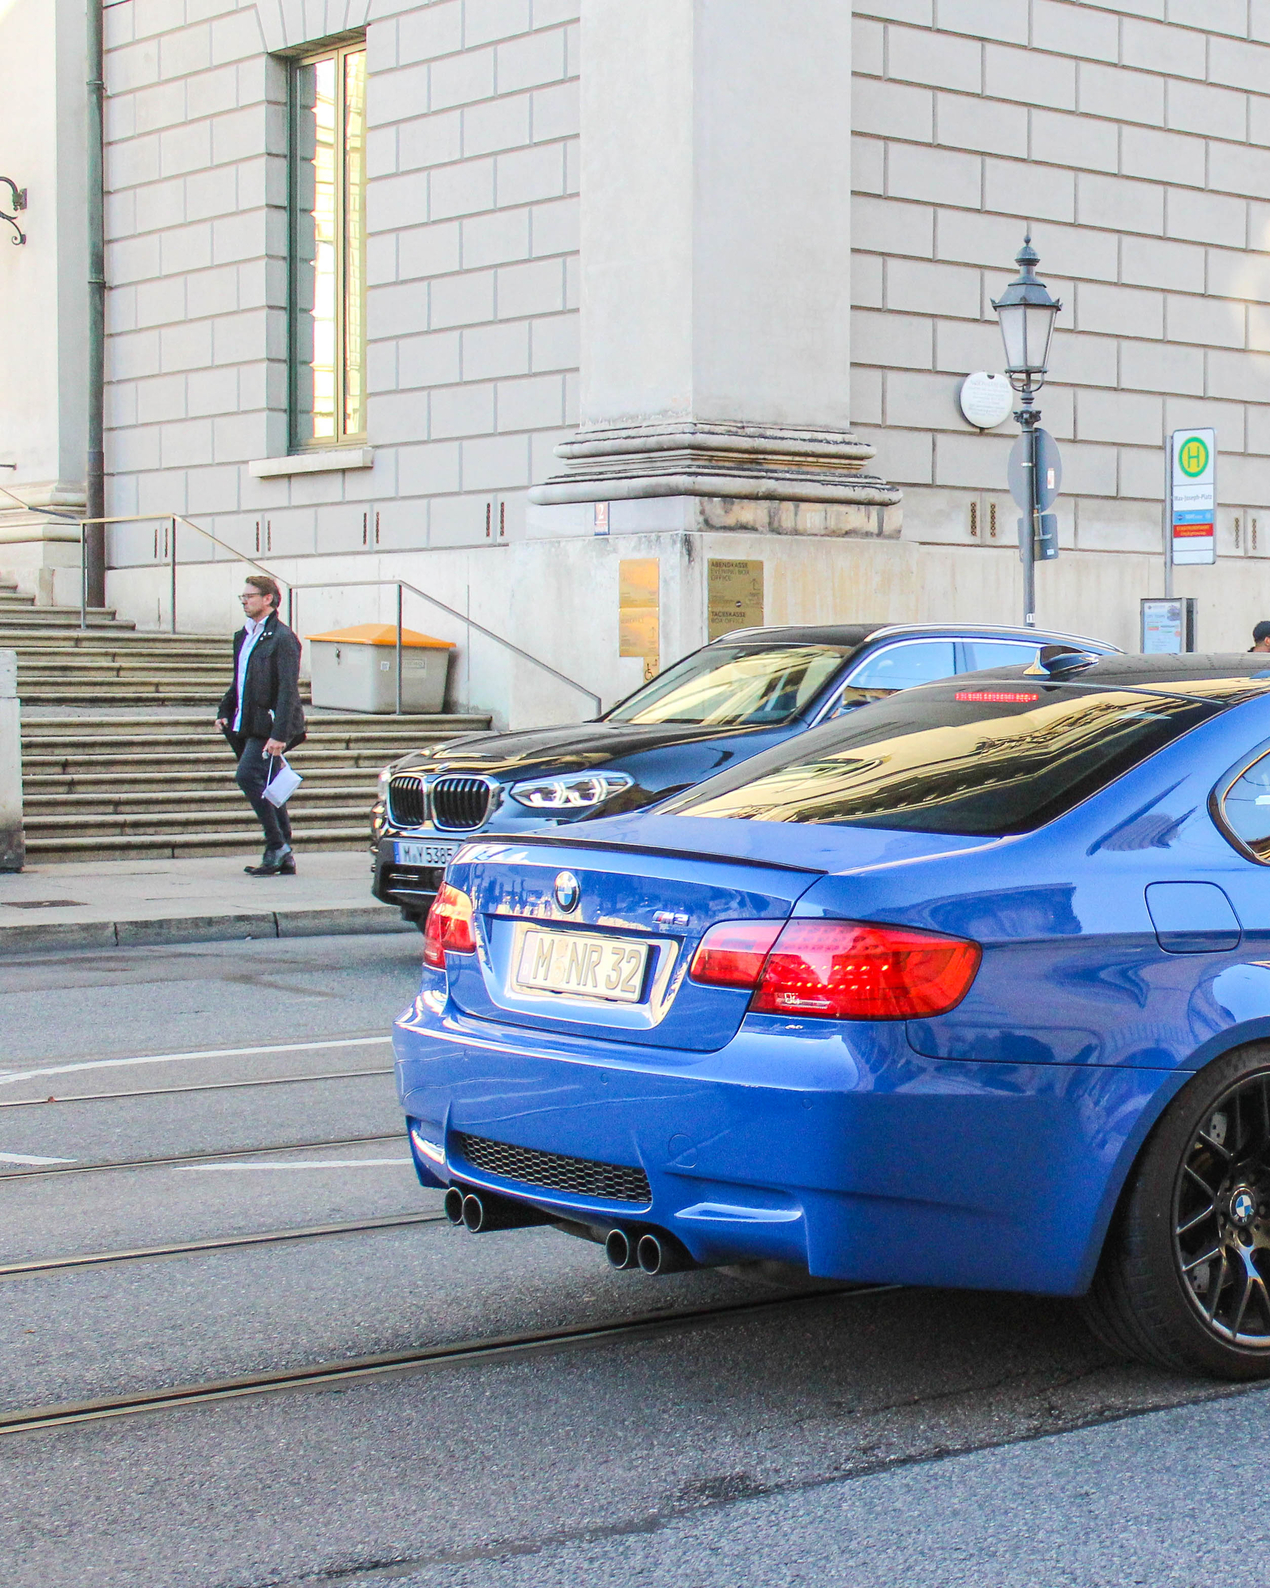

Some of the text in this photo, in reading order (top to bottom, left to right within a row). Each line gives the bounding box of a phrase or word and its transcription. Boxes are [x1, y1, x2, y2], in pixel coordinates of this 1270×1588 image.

[1187, 446, 1200, 469] H
[598, 503, 605, 520] 2
[532, 938, 642, 994] M NR 32
